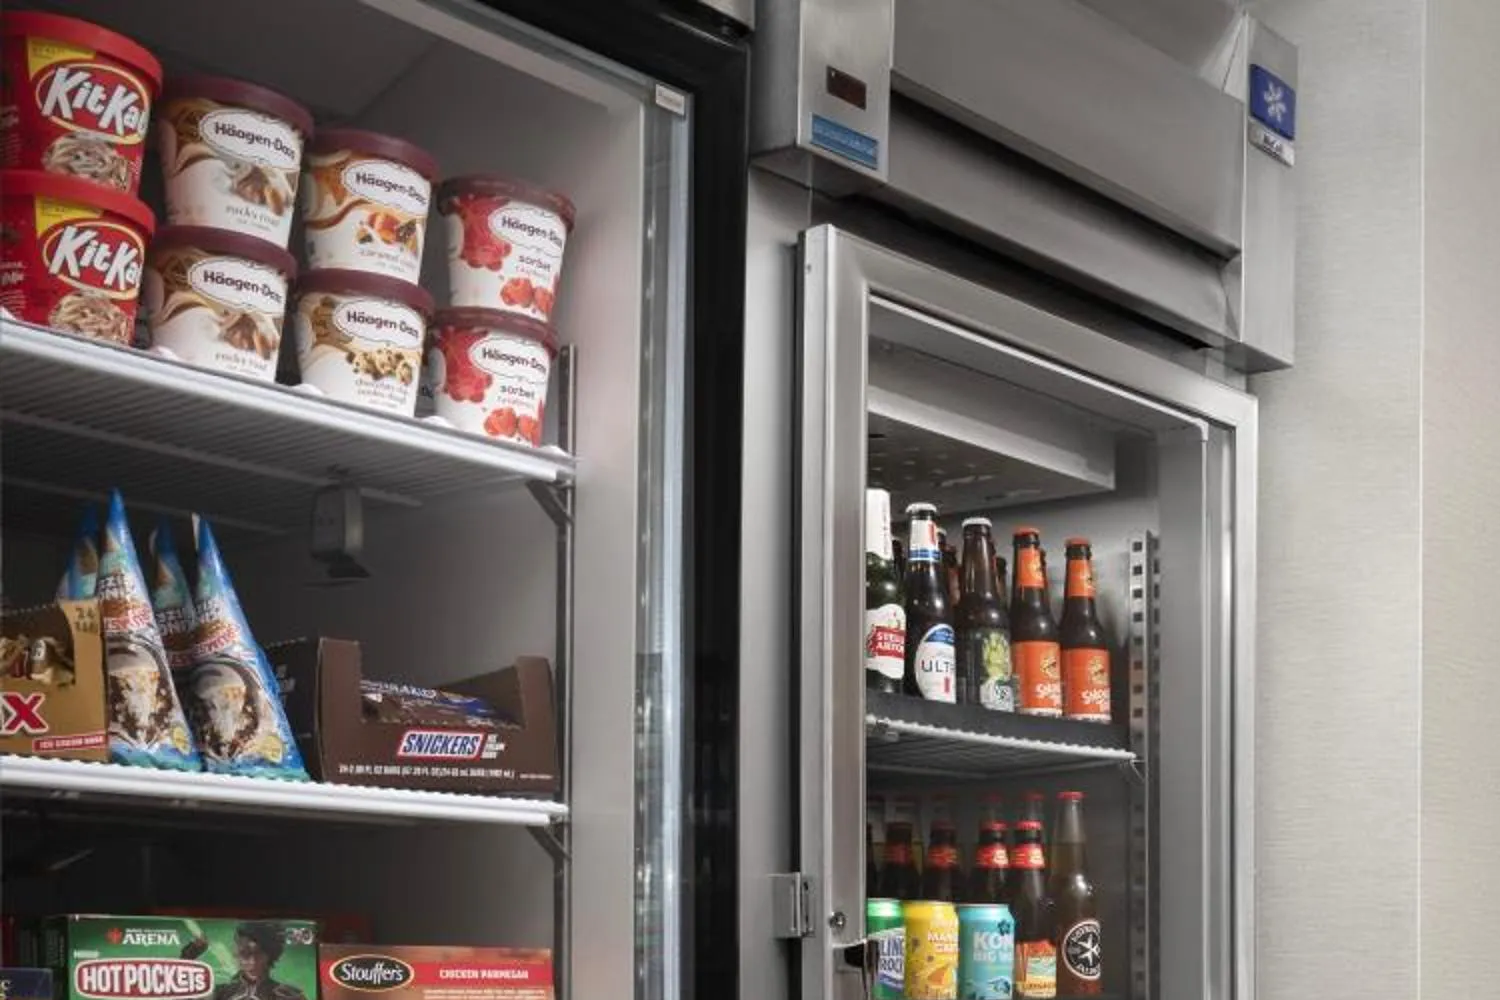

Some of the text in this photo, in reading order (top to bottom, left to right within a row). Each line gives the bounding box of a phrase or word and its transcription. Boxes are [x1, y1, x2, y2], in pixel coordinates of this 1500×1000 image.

[401, 733, 482, 757] SNICKERS
[122, 931, 181, 946] ARENA
[82, 967, 121, 993] HOT
[340, 963, 405, 986] Stouffer's
[438, 968, 530, 980] CHICKEN PARMESAN
